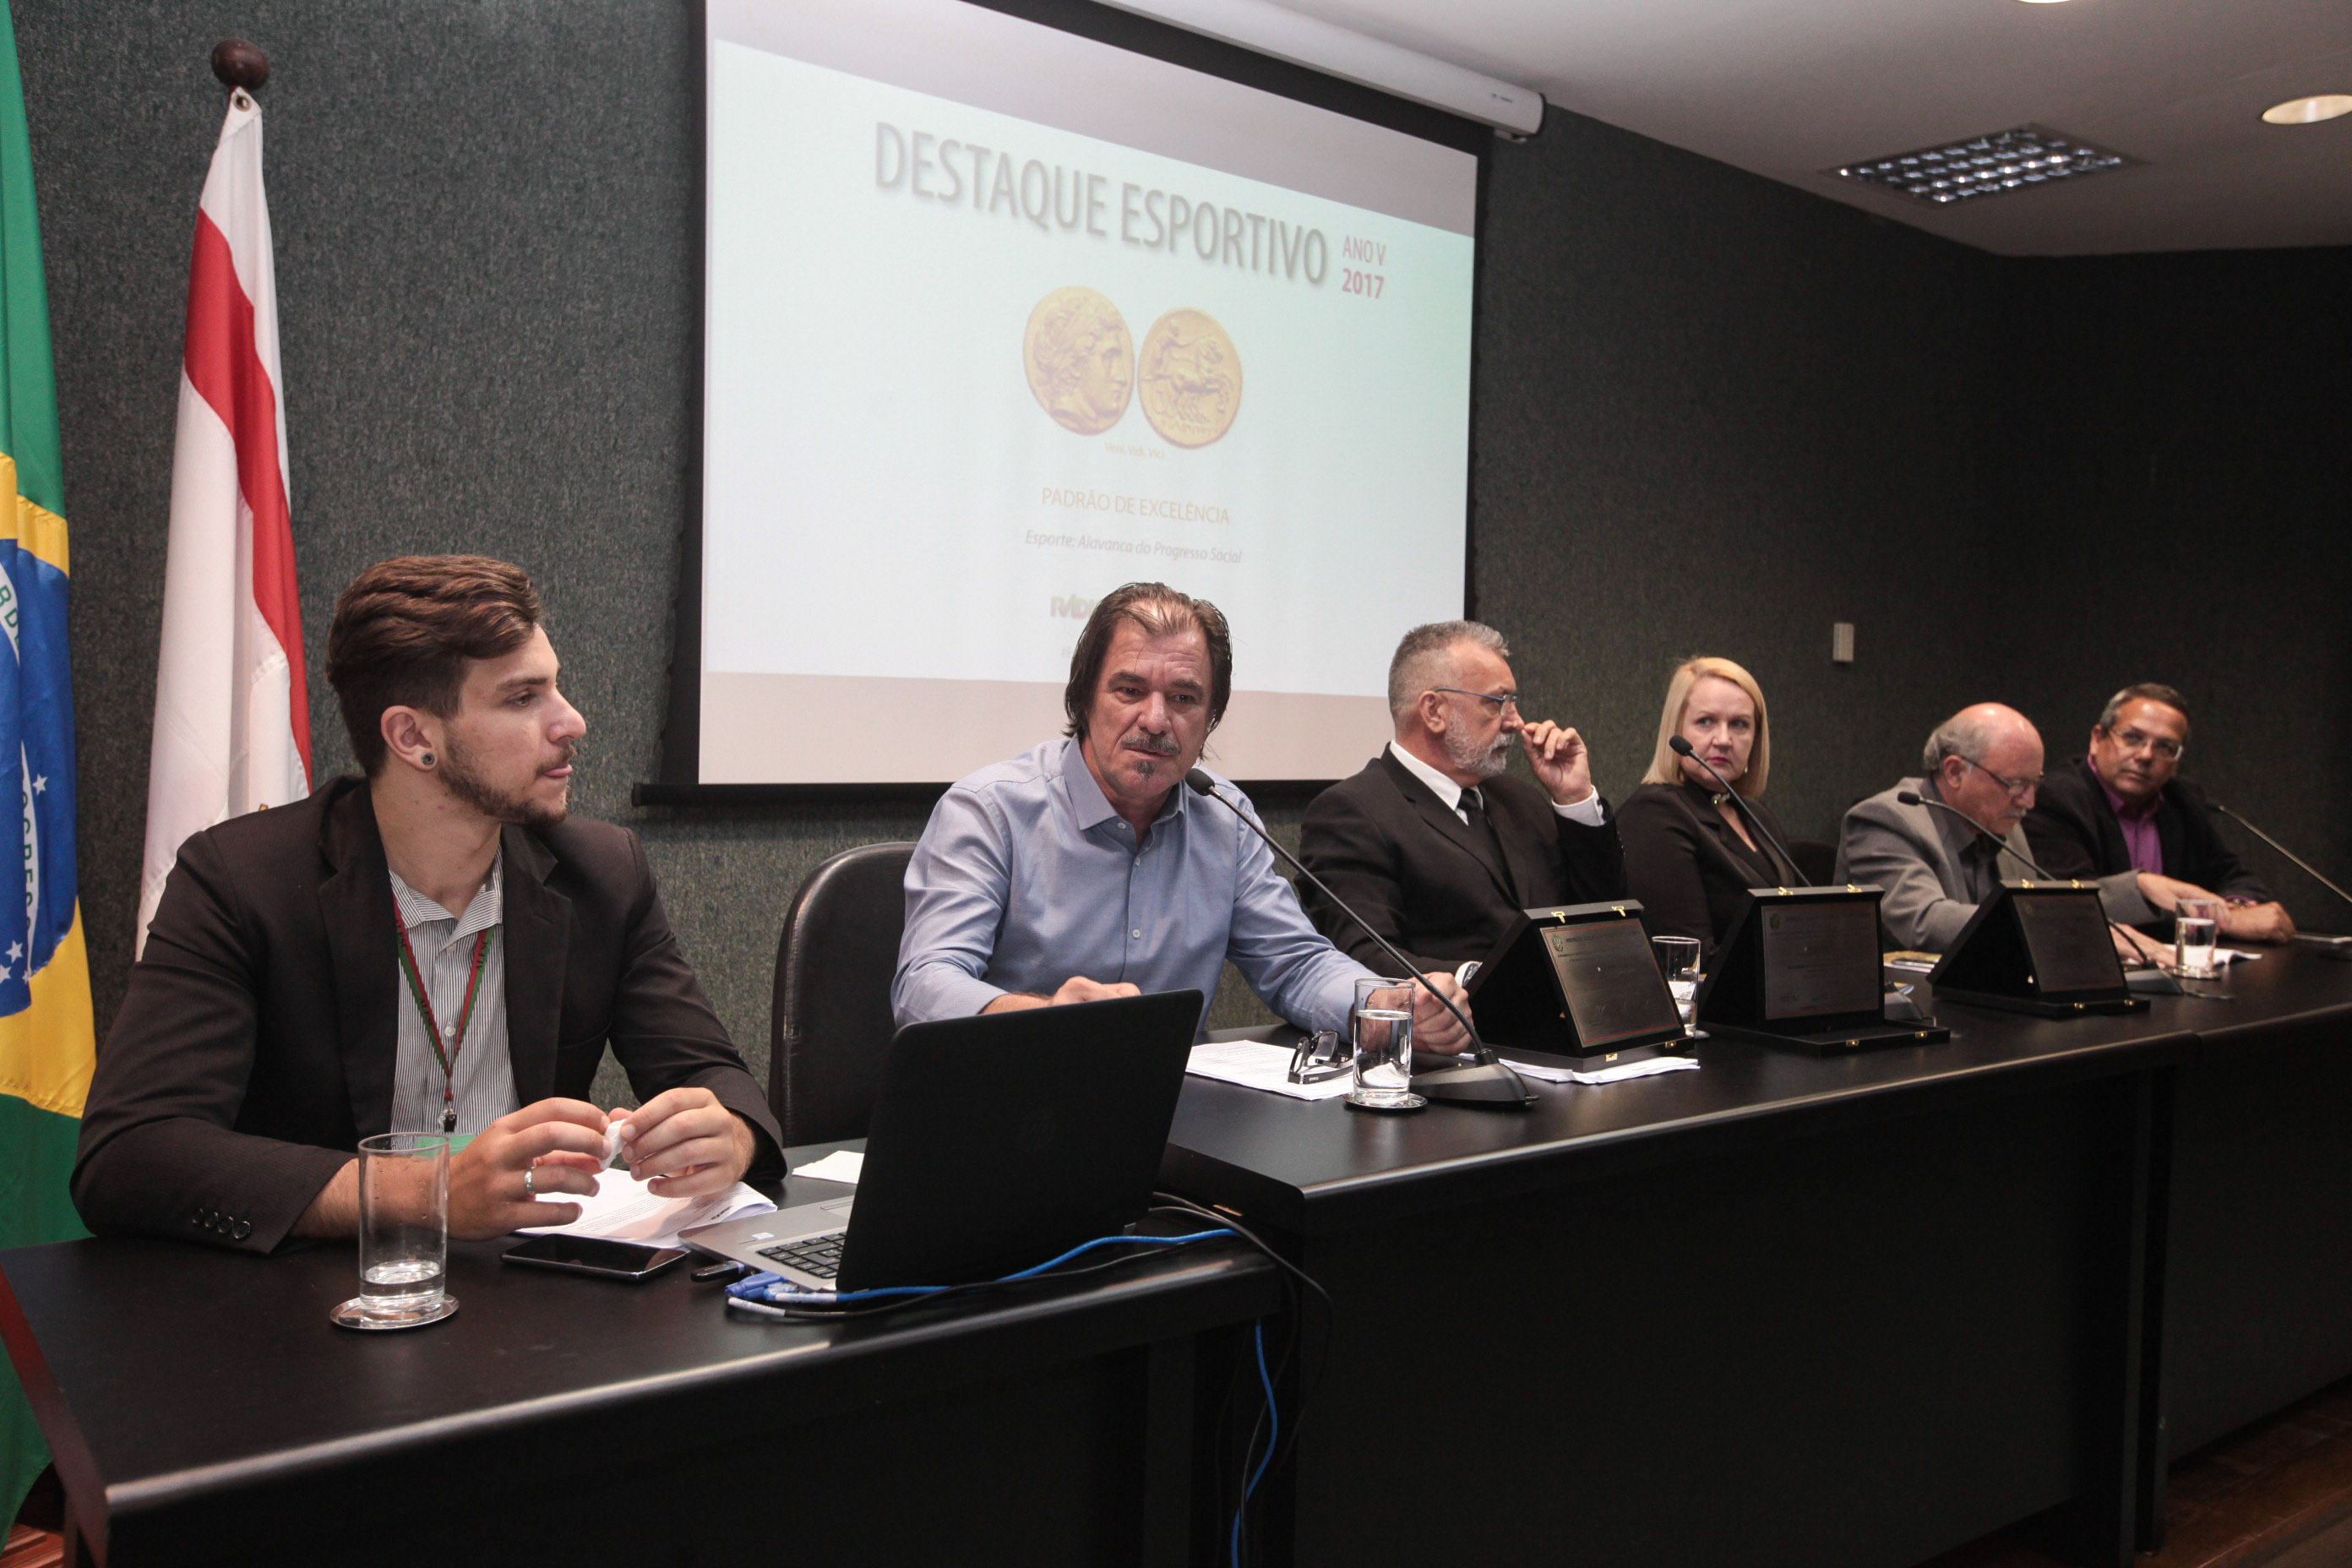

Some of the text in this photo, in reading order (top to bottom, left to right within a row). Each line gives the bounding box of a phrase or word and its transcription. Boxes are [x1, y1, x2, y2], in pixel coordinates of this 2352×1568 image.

[875, 121, 1327, 286] DESTAQUE ESPORTIVO
[1342, 236, 1386, 267] ANO V
[1342, 268, 1385, 299] 2017
[1042, 487, 1230, 525] PADRÃO DE EXCELÊNCIA
[1026, 530, 1243, 564] Esporte: Alavanca do Progresso Social
